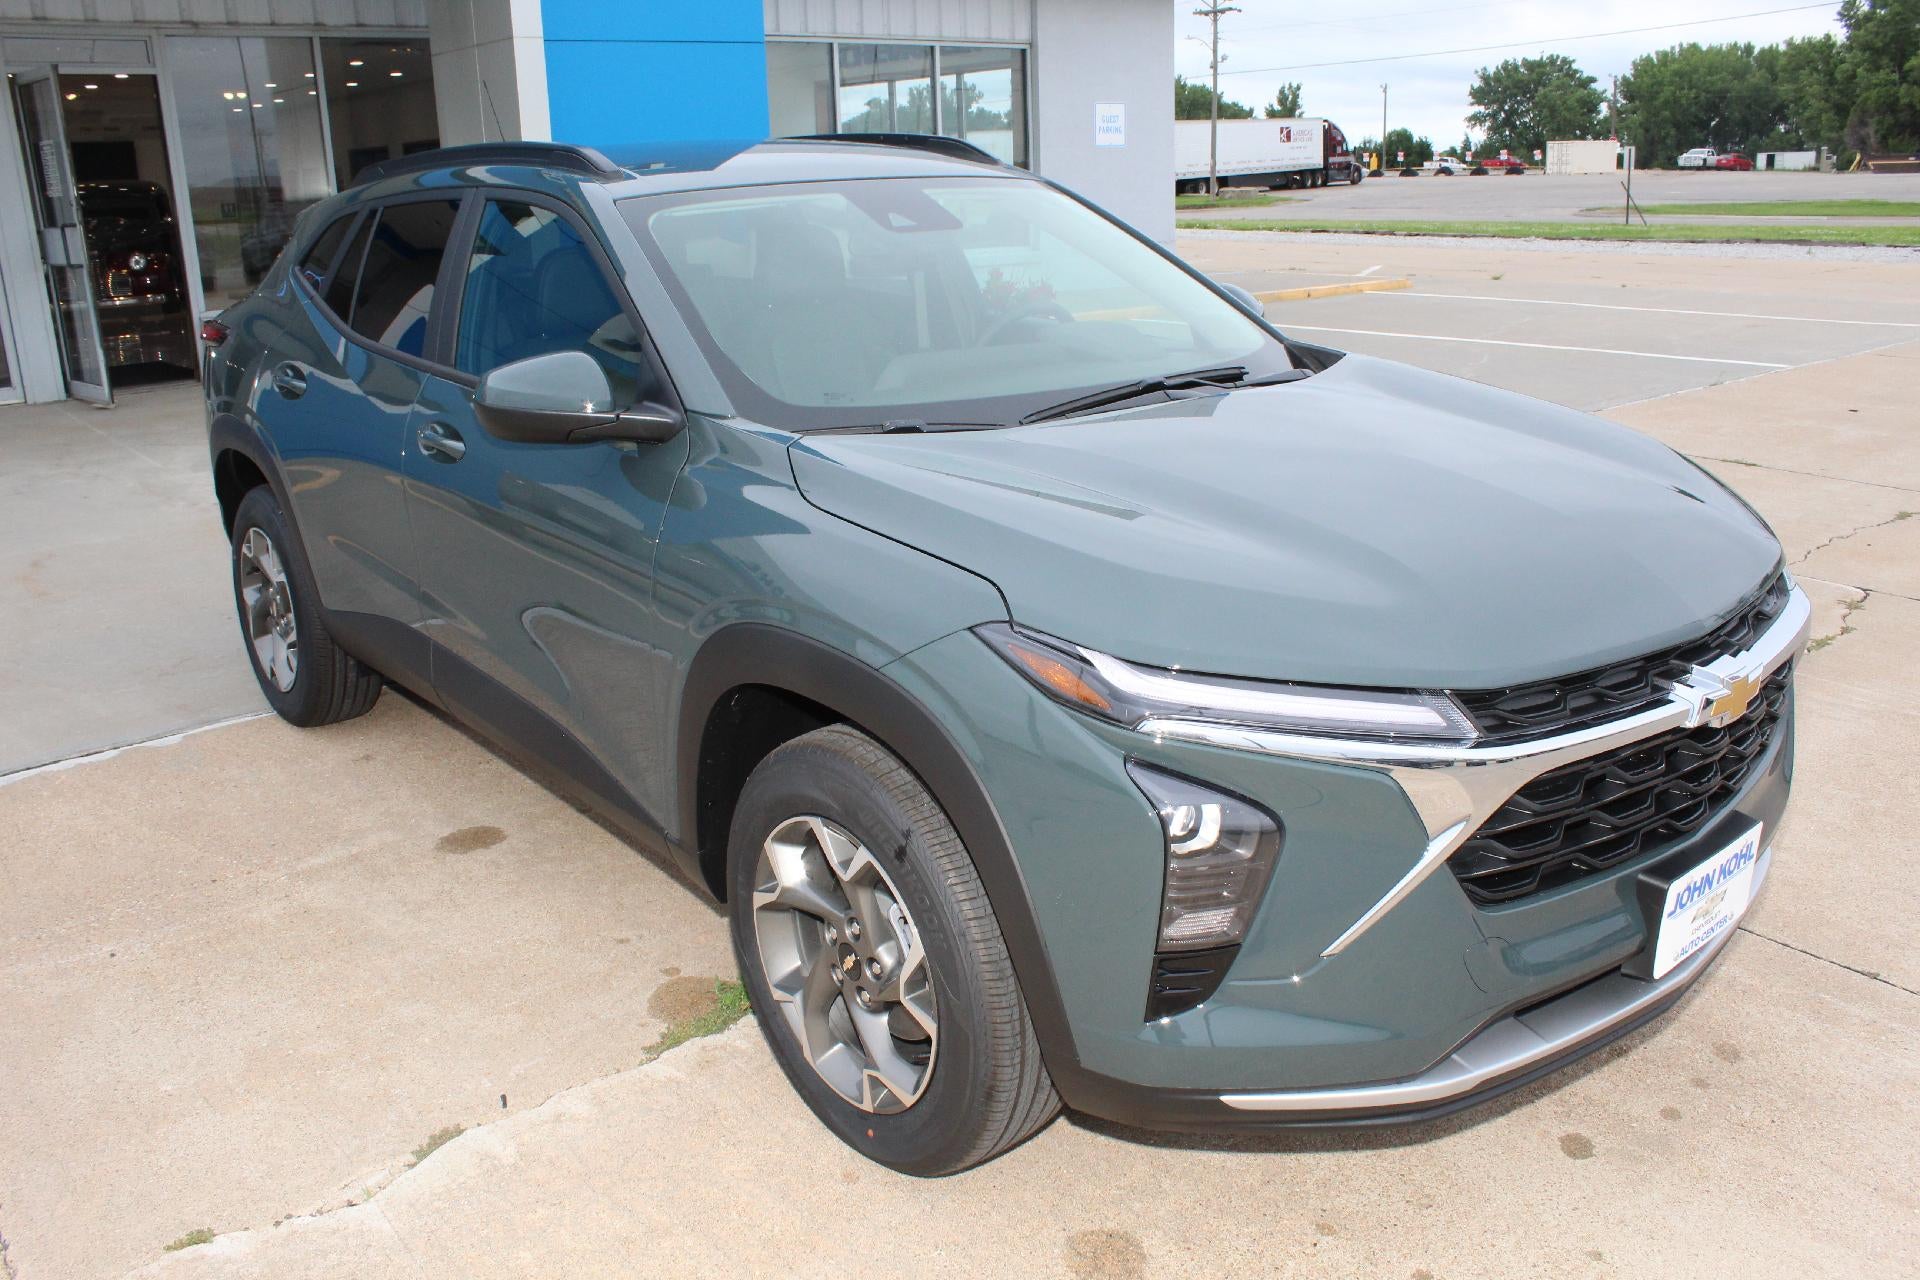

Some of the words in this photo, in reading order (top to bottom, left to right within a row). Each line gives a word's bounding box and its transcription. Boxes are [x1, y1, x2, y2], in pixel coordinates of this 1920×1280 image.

[1098, 126, 1122, 134] PARKING
[1101, 114, 1119, 123] GUEST
[1667, 868, 1717, 919] JOHN
[1716, 841, 1755, 884] KOHL
[1679, 936, 1701, 957] AUTO
[1701, 914, 1729, 941] CENTER
